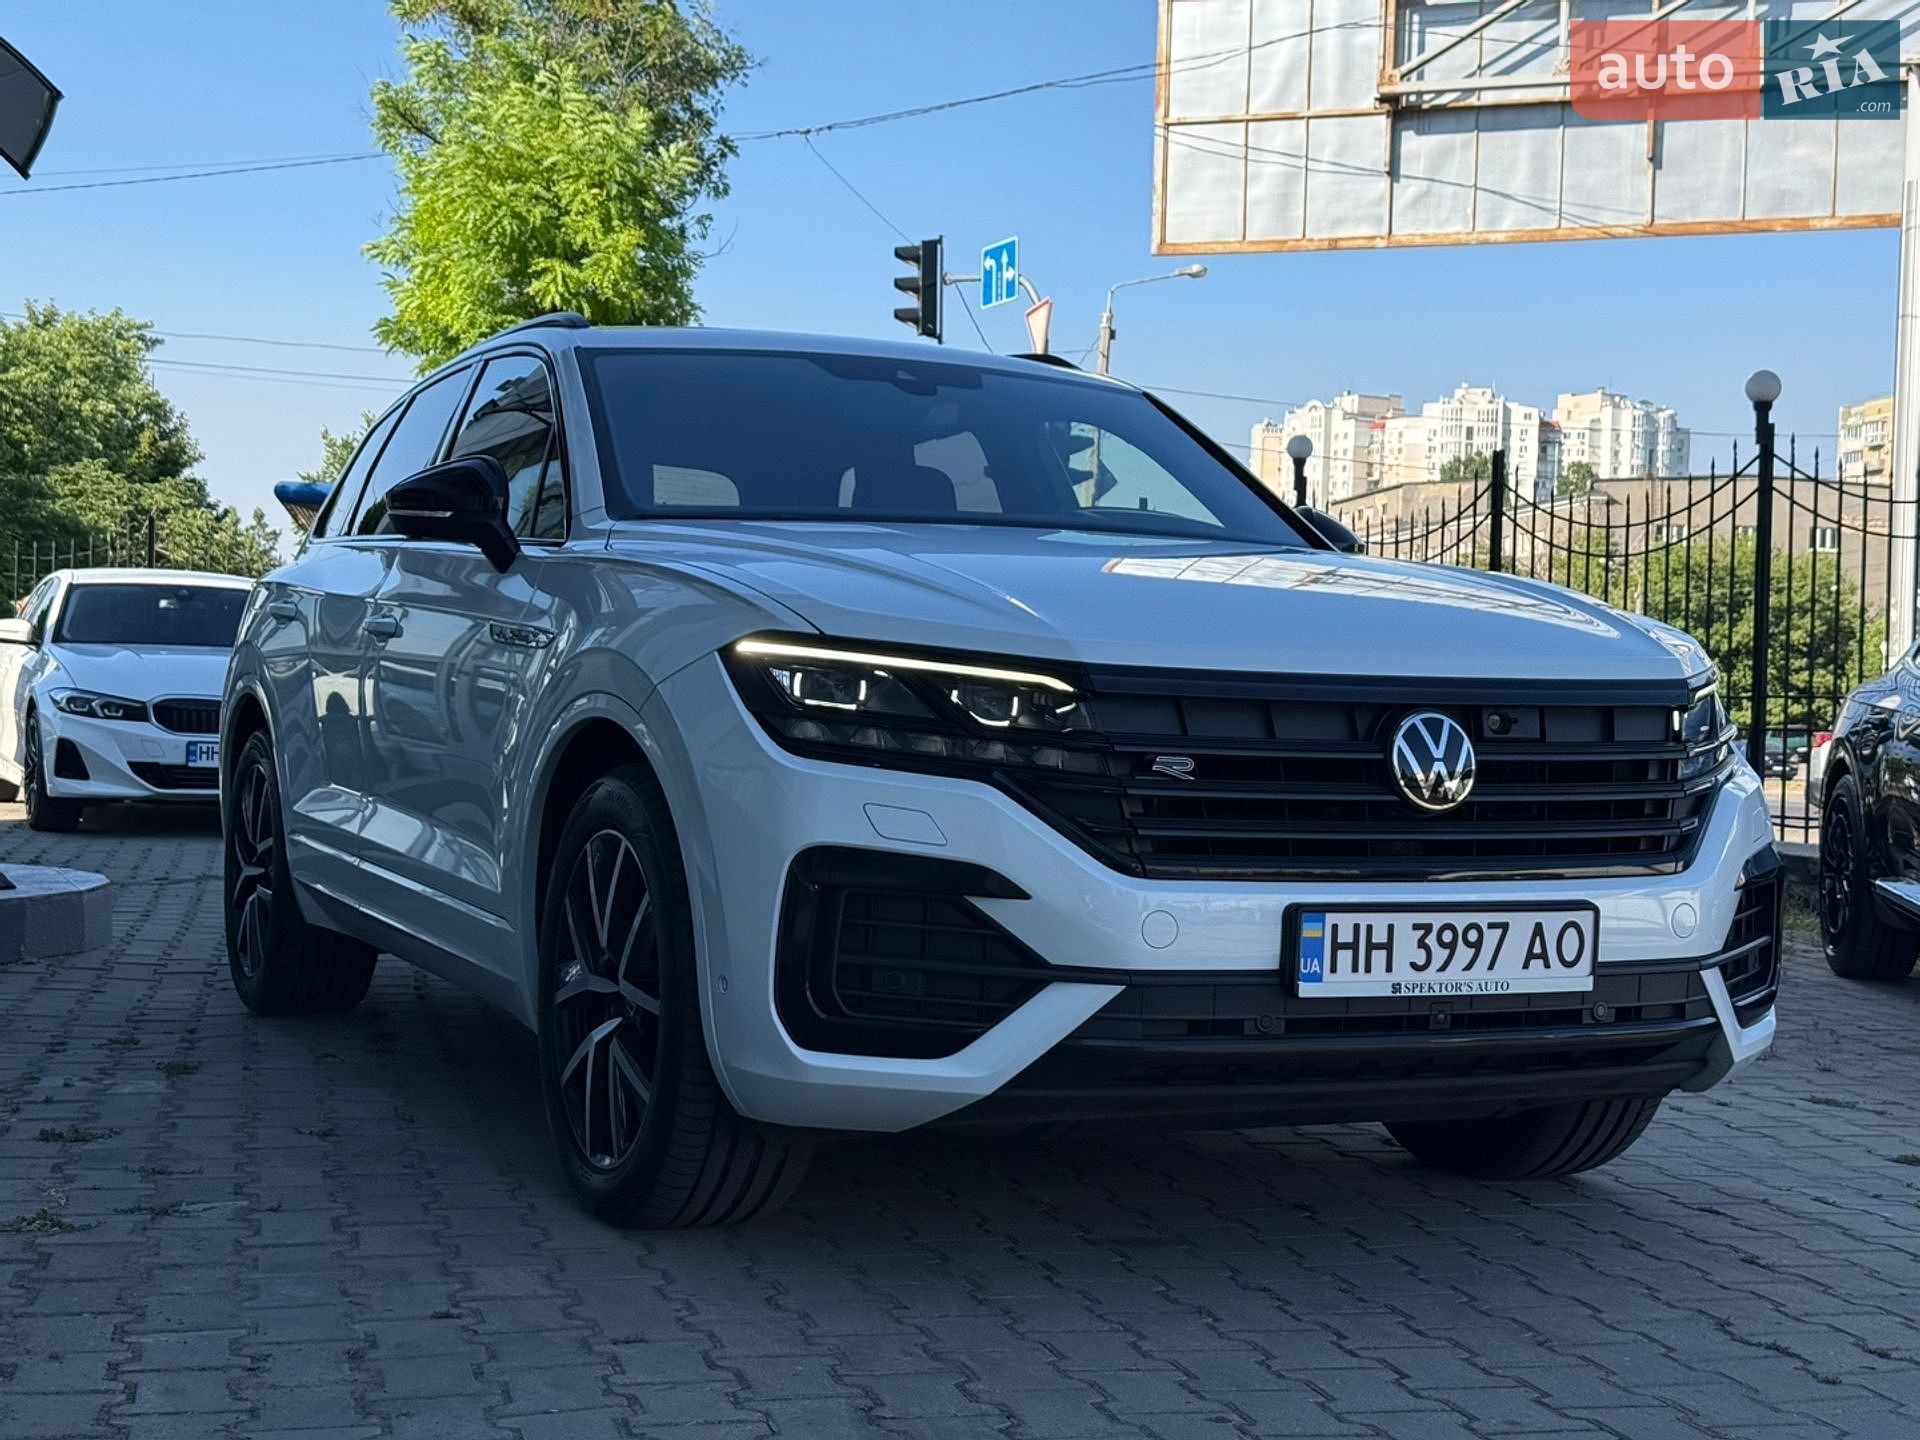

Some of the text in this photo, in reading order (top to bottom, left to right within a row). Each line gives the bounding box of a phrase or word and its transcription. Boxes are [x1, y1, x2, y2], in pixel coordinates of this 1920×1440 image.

[1329, 919, 1586, 973] HH 3997 AO
[1300, 957, 1320, 973] UA
[1403, 980, 1510, 994] SPEKTOR'S AUTO
